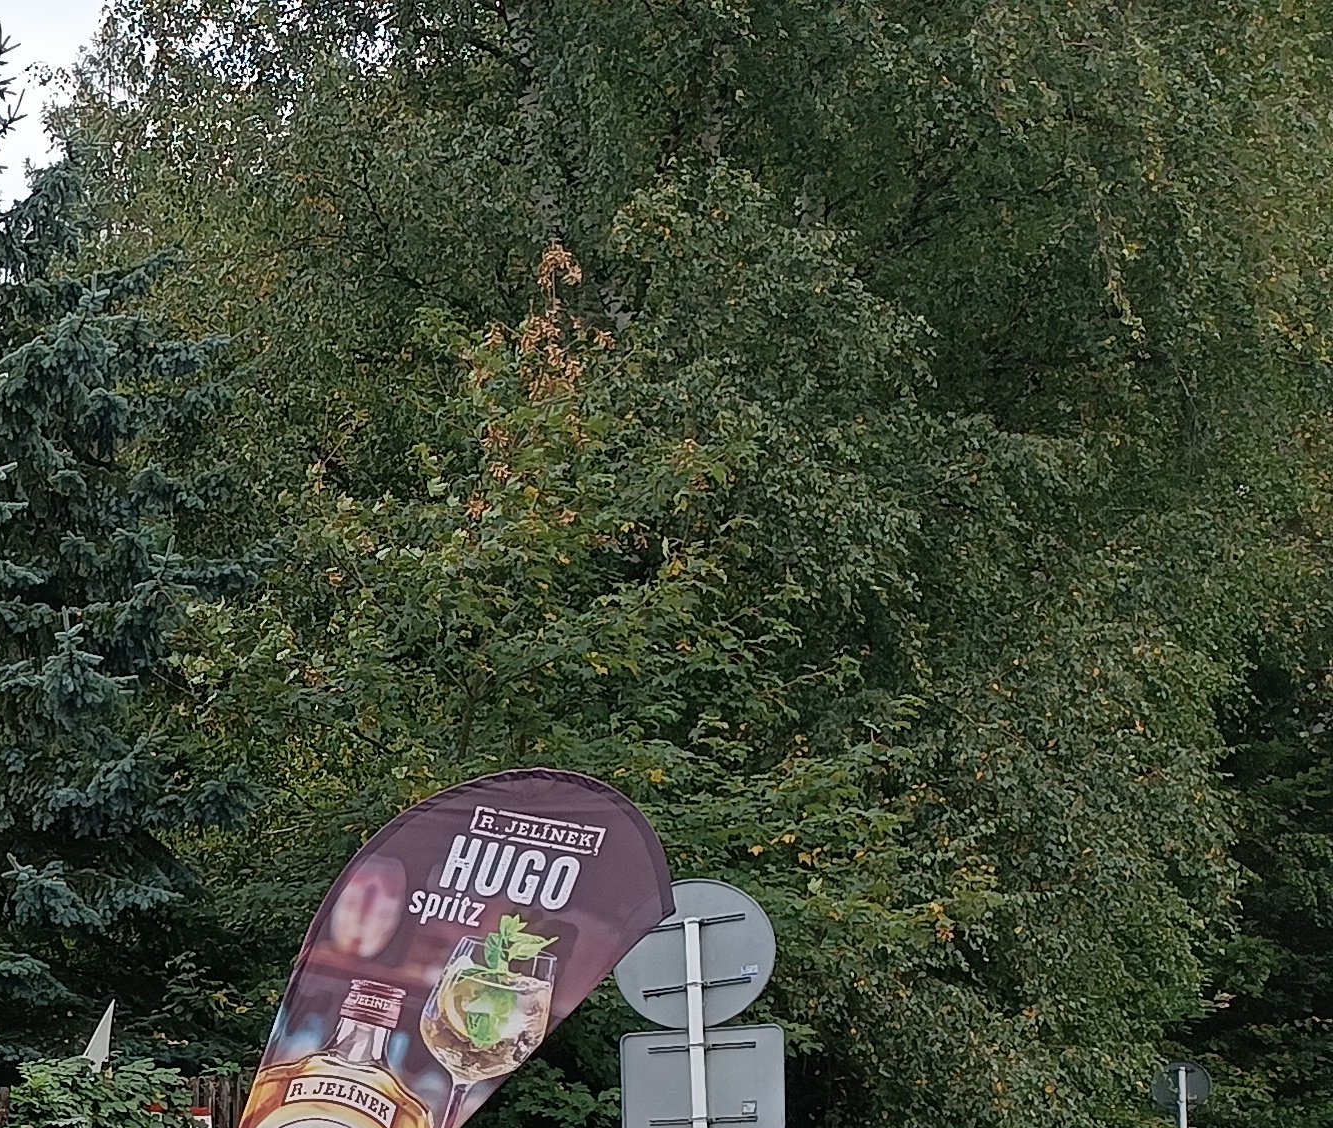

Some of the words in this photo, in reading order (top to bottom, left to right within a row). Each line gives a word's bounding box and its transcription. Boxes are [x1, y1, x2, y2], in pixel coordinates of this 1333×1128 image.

[479, 815, 499, 831] R.
[505, 820, 594, 848] JELÍNEK
[439, 835, 581, 910] HUGO
[409, 891, 486, 927] spritz
[290, 1082, 308, 1098] R.
[313, 1082, 391, 1121] JELÍNEK
